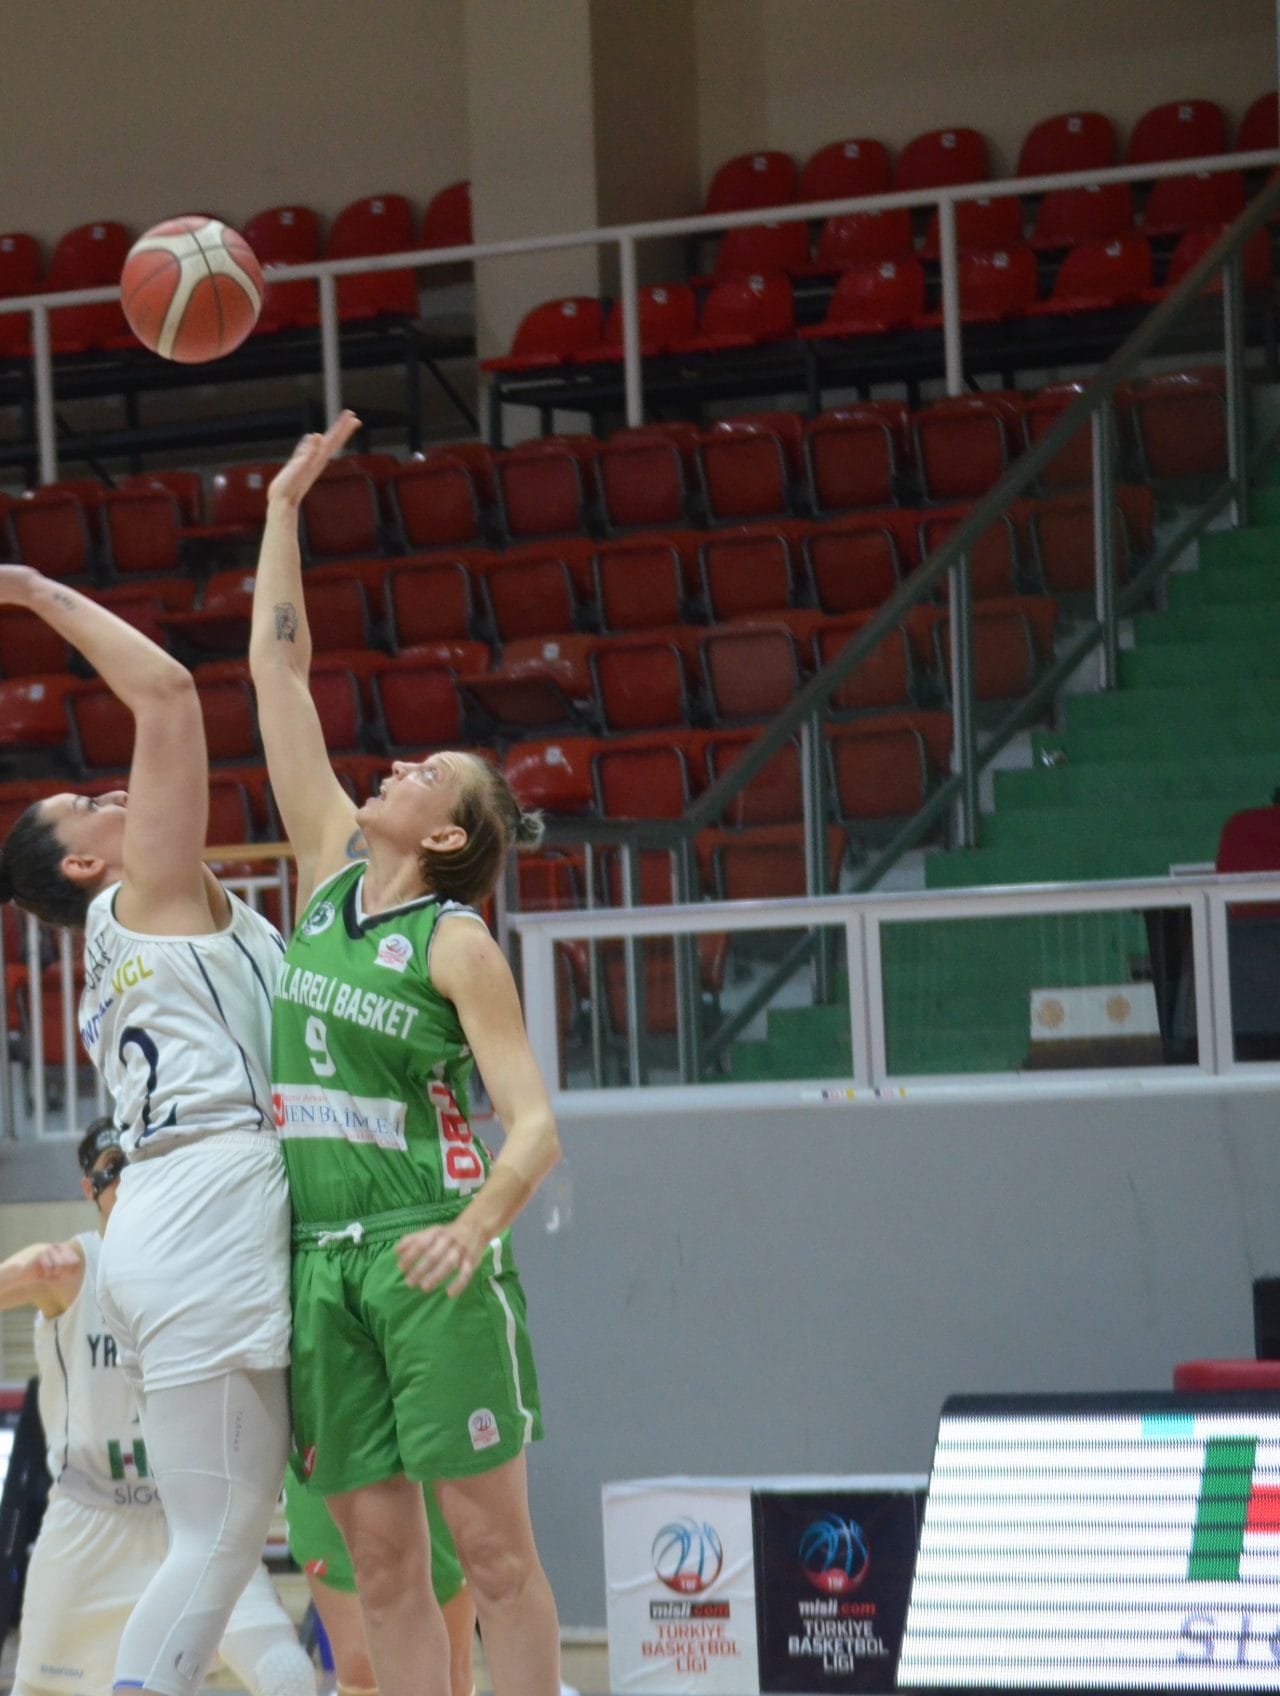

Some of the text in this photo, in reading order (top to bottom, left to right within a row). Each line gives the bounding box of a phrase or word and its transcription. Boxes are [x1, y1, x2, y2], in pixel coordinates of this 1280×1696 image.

[111, 954, 154, 993] VGL
[332, 982, 419, 1040] BASKET
[305, 1015, 336, 1078] 9
[118, 1026, 178, 1149] 2
